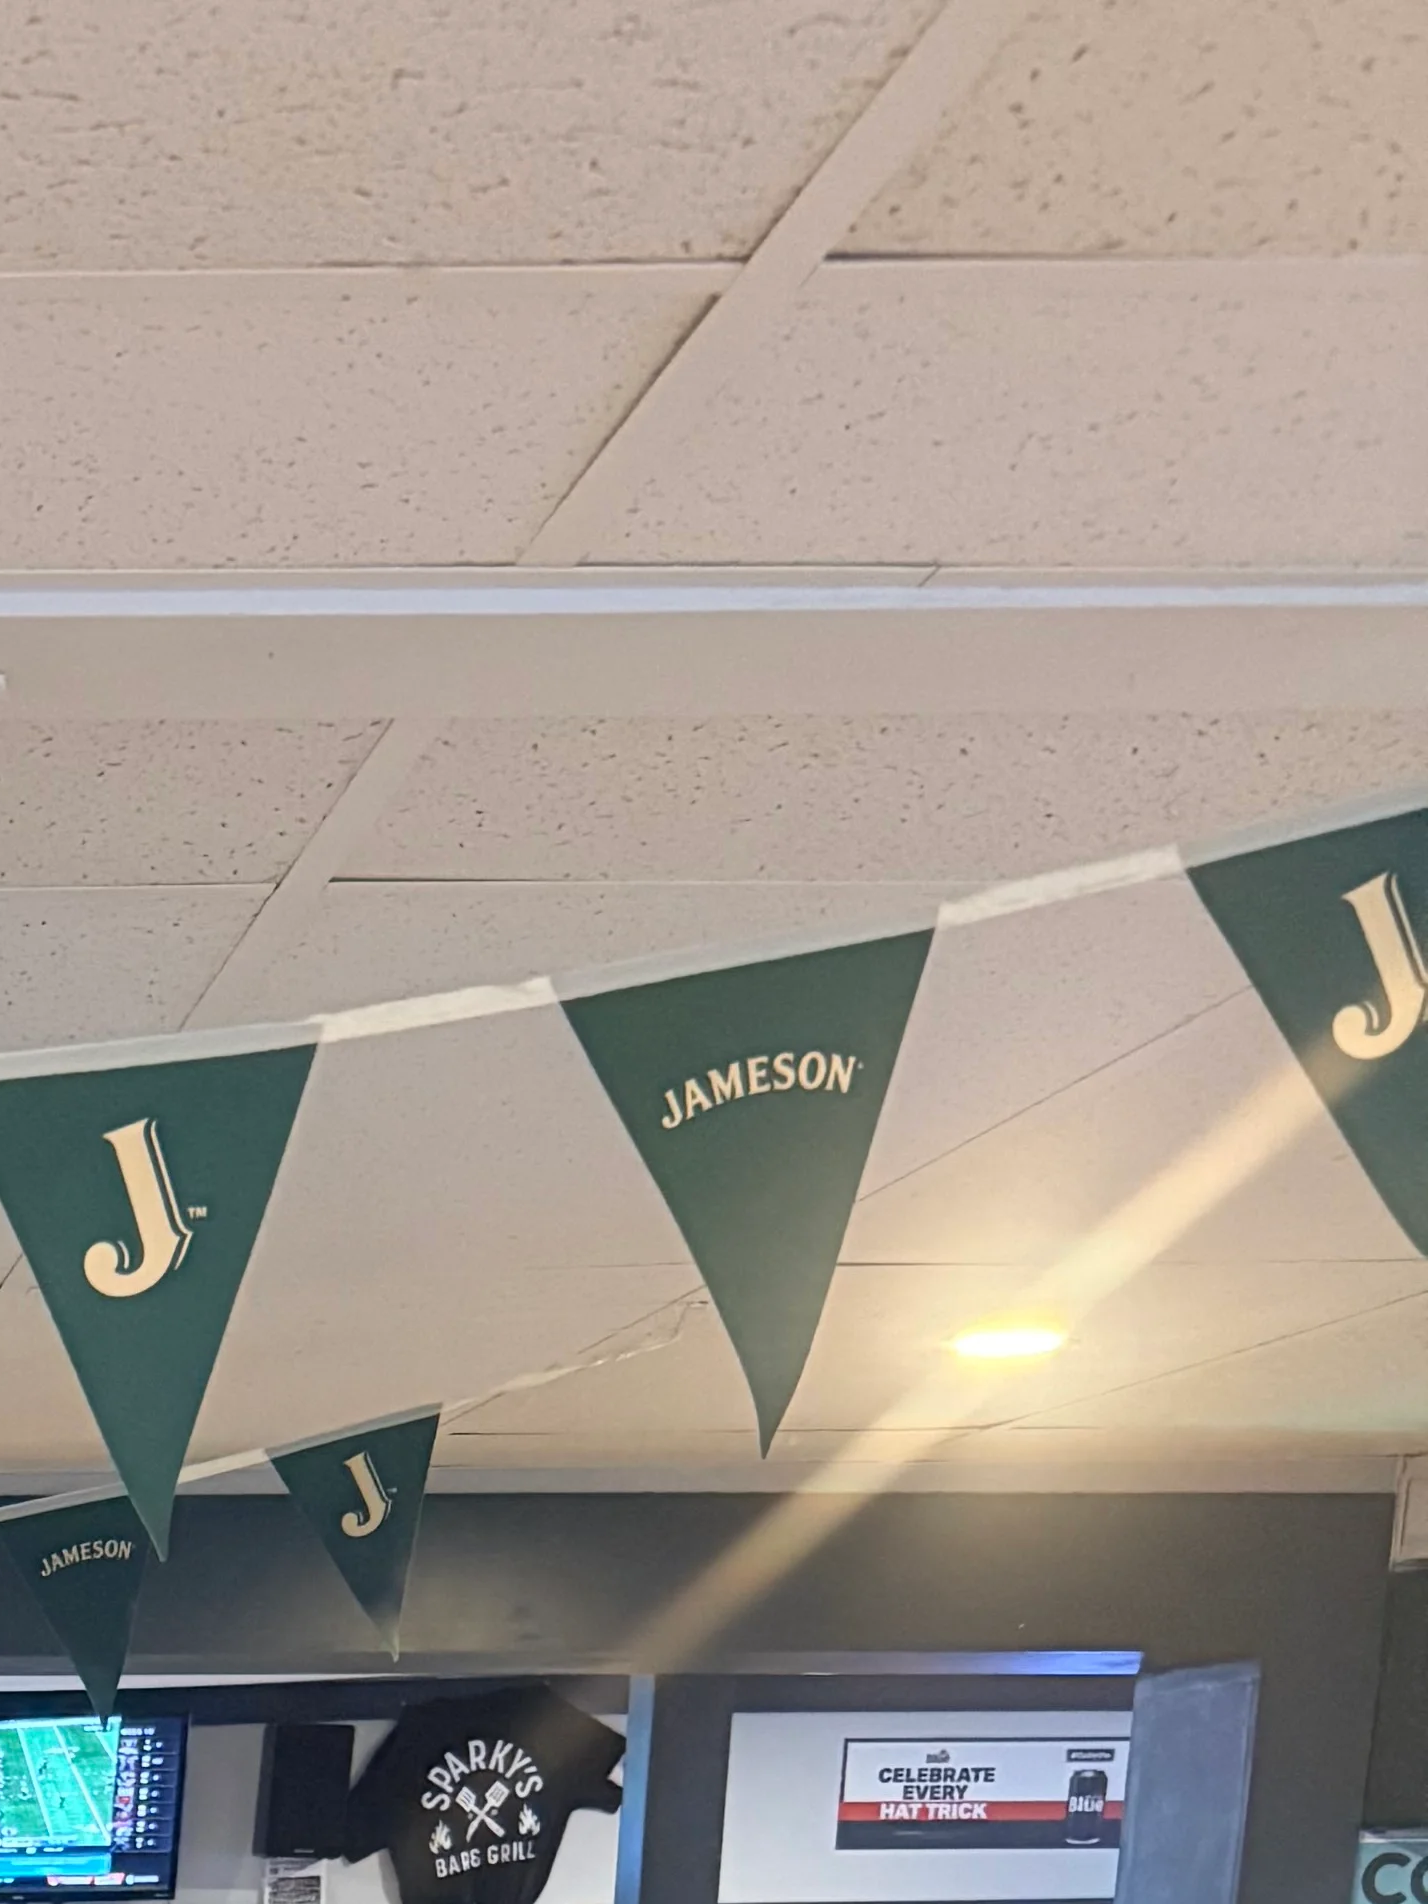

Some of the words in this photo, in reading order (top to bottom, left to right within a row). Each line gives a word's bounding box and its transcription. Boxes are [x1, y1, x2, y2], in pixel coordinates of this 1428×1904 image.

[662, 1051, 857, 1129] JAMESON
[84, 1118, 193, 1298] J
[341, 1451, 392, 1538] J
[40, 1539, 134, 1578] JAMESON
[421, 1739, 544, 1812] SPARKY'S
[878, 1767, 997, 1784] CELEBRATE
[902, 1785, 969, 1801] EVERY
[879, 1803, 924, 1820] HAT
[925, 1803, 988, 1820] TRICK
[487, 1840, 536, 1865] GRILL
